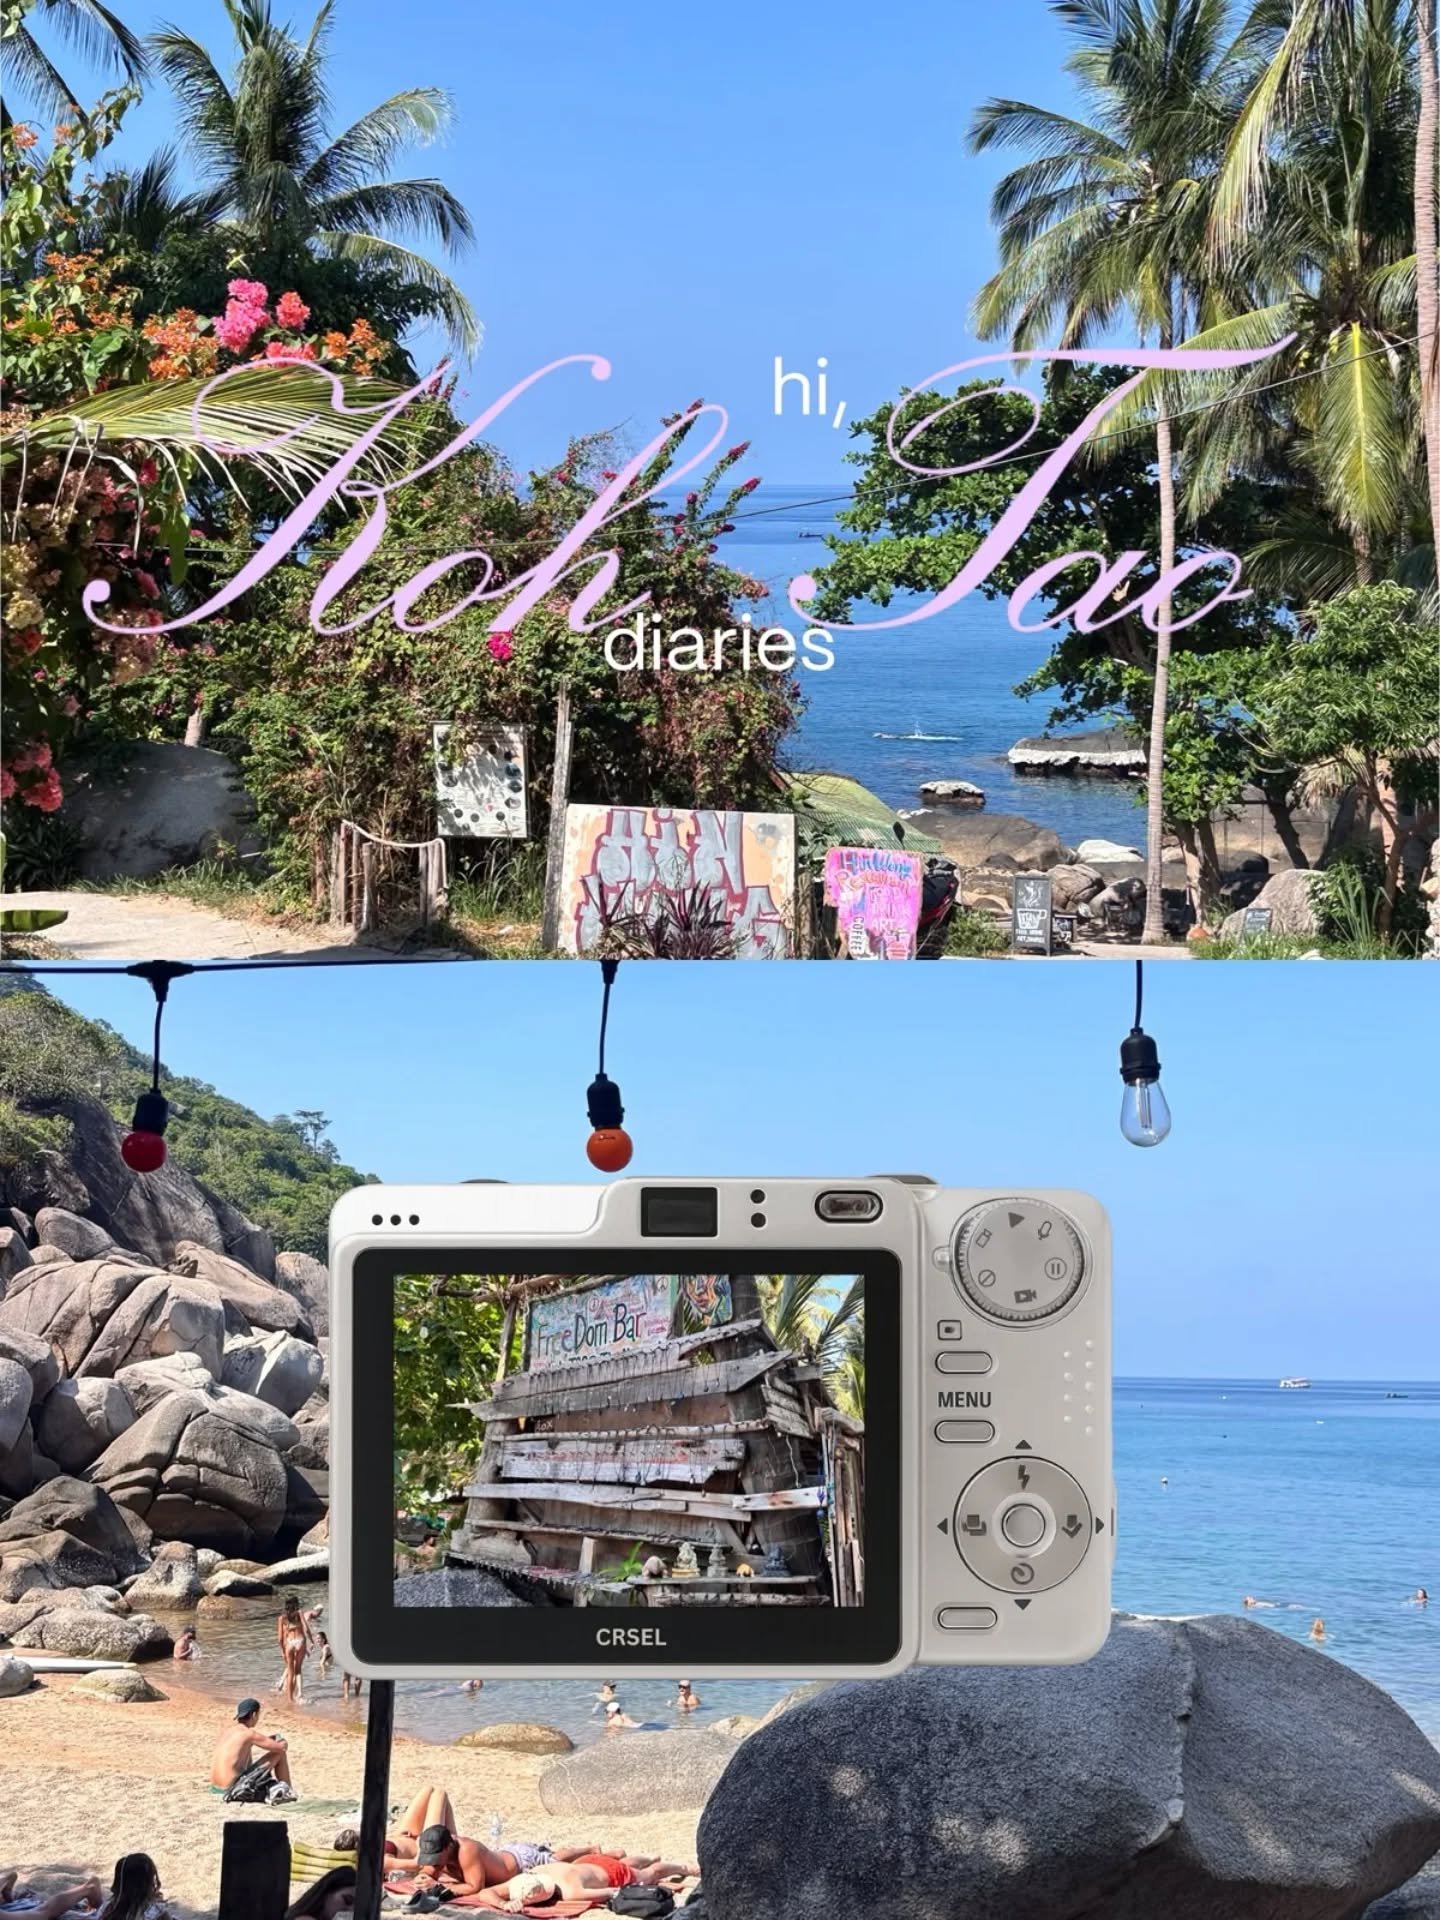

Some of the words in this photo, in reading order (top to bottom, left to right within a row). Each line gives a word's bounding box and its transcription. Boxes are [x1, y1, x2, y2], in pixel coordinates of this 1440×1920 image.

[850, 916, 864, 950] COFFEE
[613, 1303, 647, 1342] Bar
[937, 1391, 993, 1409] MENU
[595, 1628, 668, 1647] CRSEL
